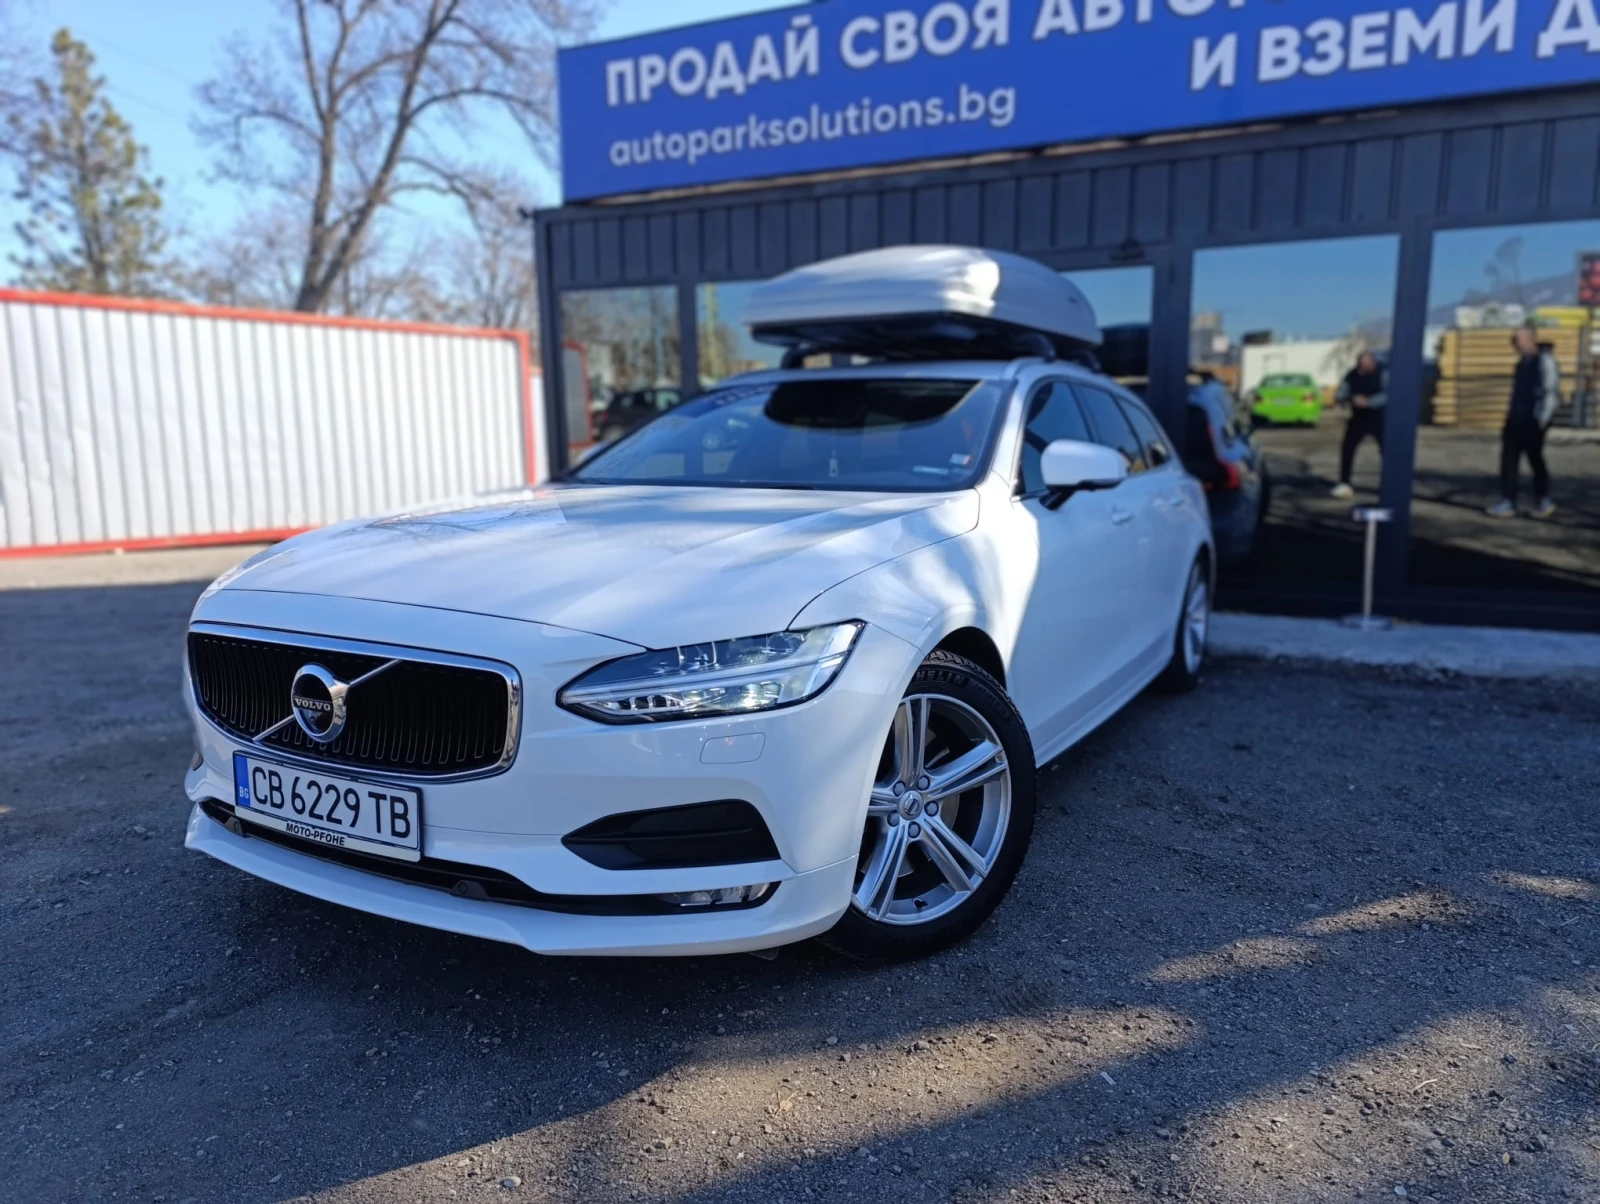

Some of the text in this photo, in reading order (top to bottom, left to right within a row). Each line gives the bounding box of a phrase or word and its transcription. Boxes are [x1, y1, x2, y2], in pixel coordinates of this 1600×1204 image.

[606, 15, 819, 106] ПРОДАЙ
[840, 0, 1010, 68] СВОЯ
[1190, 33, 1238, 91] И
[1257, 0, 1517, 82] ВЗЕМИ
[609, 85, 1016, 166] autoparksolutions.bg
[294, 698, 331, 711] VOLVO
[239, 785, 250, 799] BG
[252, 766, 411, 839] CB 6229 TB
[285, 822, 346, 847] MOTO-PFOHE
